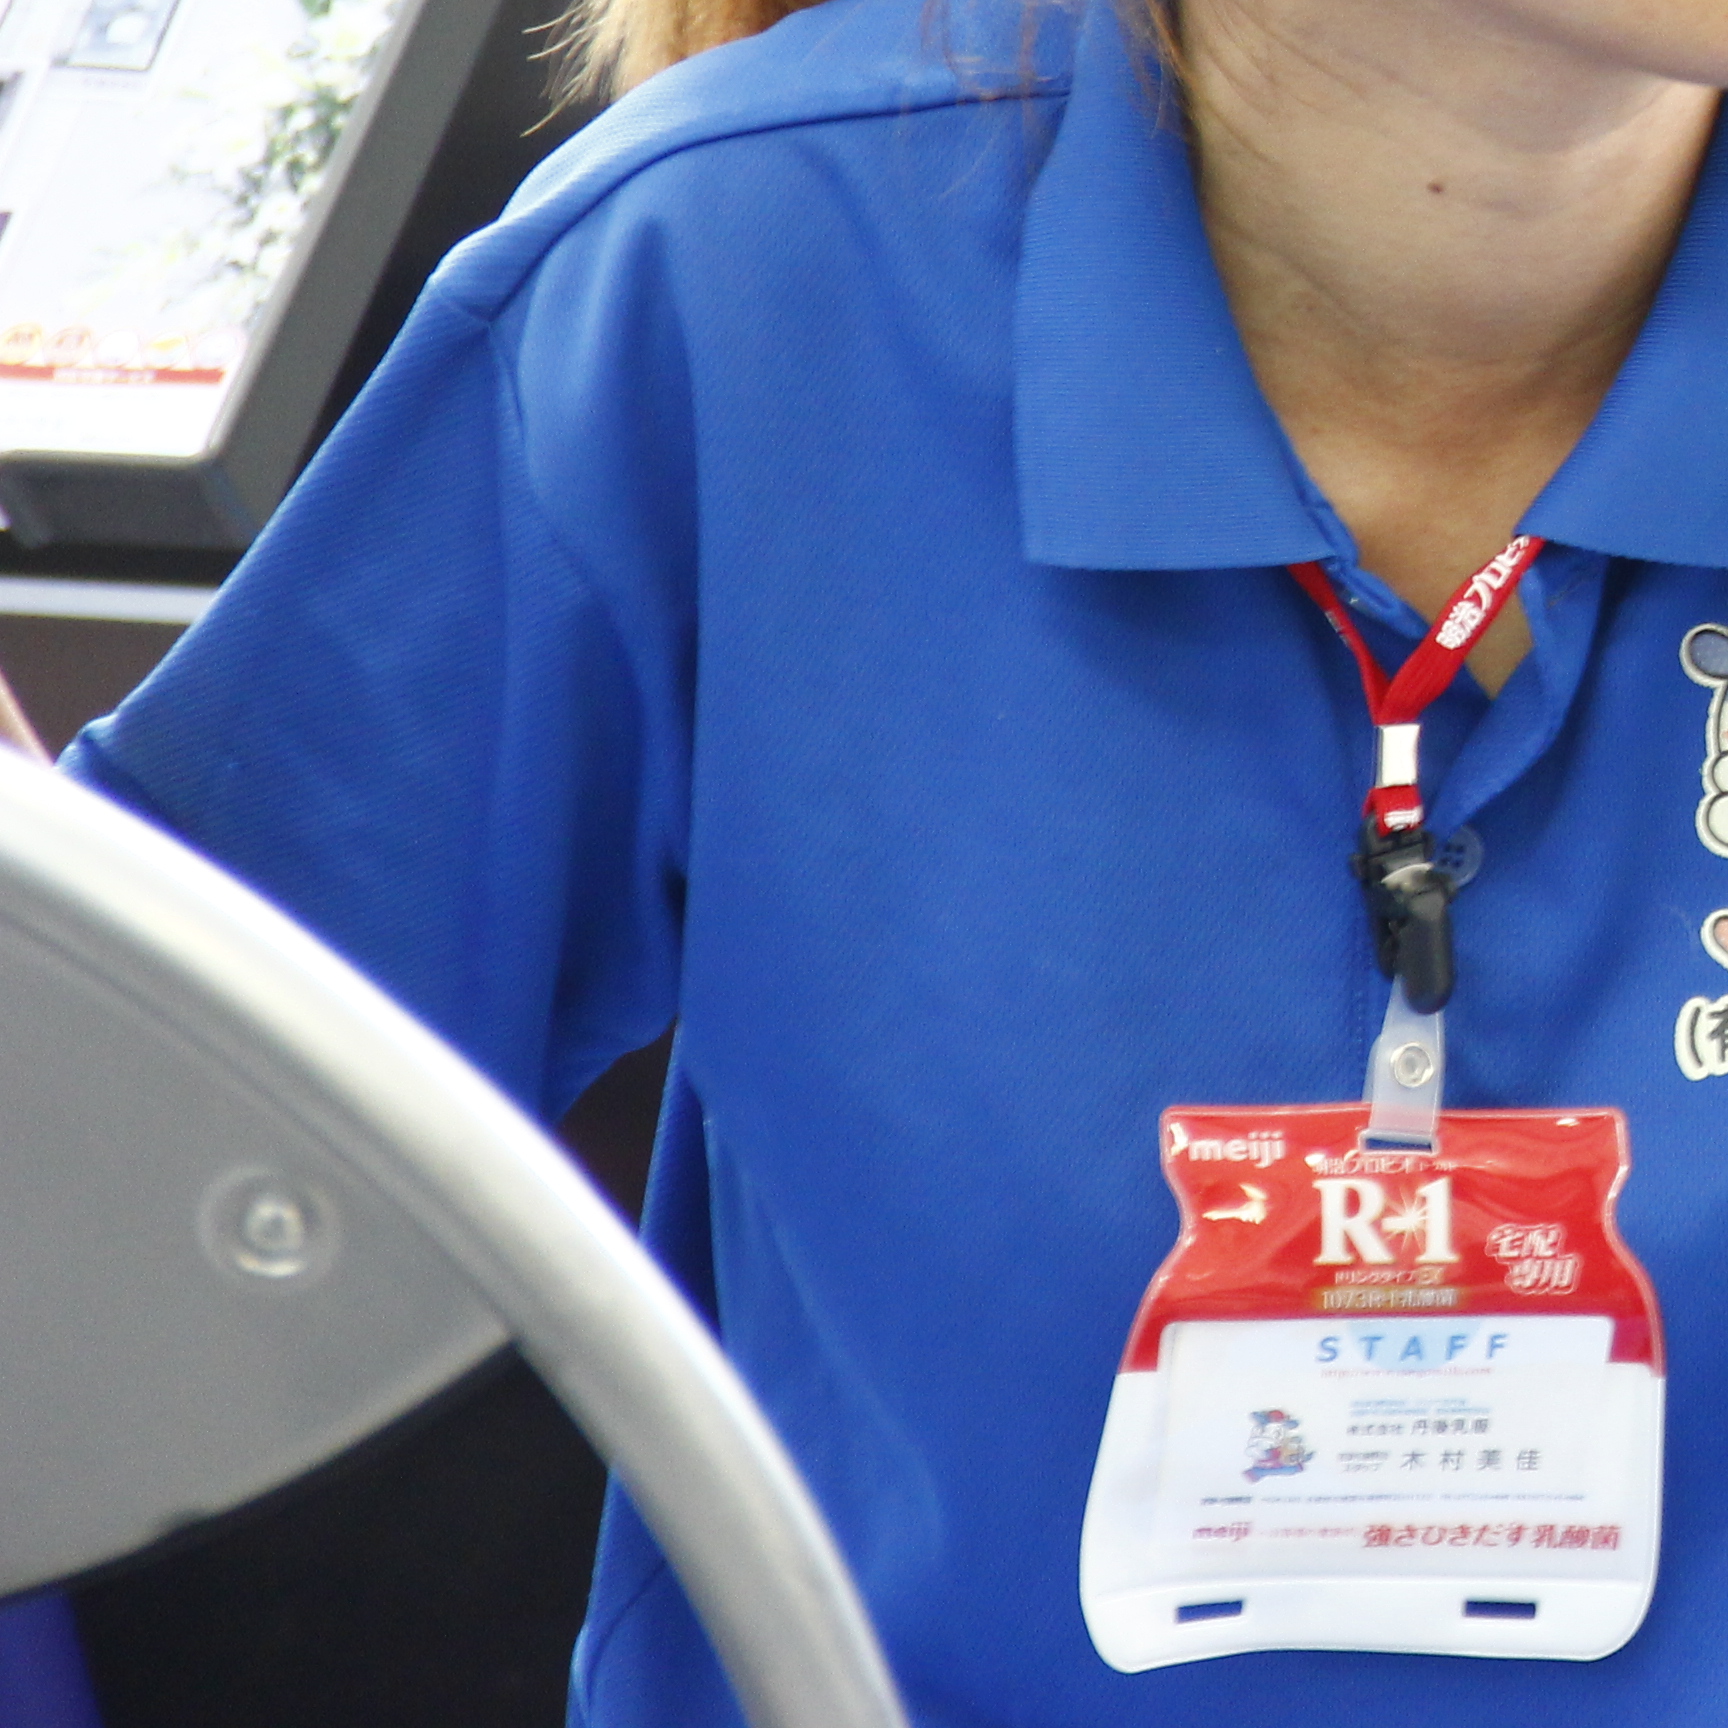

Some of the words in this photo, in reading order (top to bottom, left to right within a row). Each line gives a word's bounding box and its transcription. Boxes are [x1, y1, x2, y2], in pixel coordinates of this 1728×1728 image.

[1188, 1130, 1287, 1167] meiji
[1311, 1176, 1461, 1266] R-1
[1490, 1226, 1559, 1259] 宅配
[1316, 1332, 1511, 1363] STAFF
[1192, 1520, 1253, 1543] meiji
